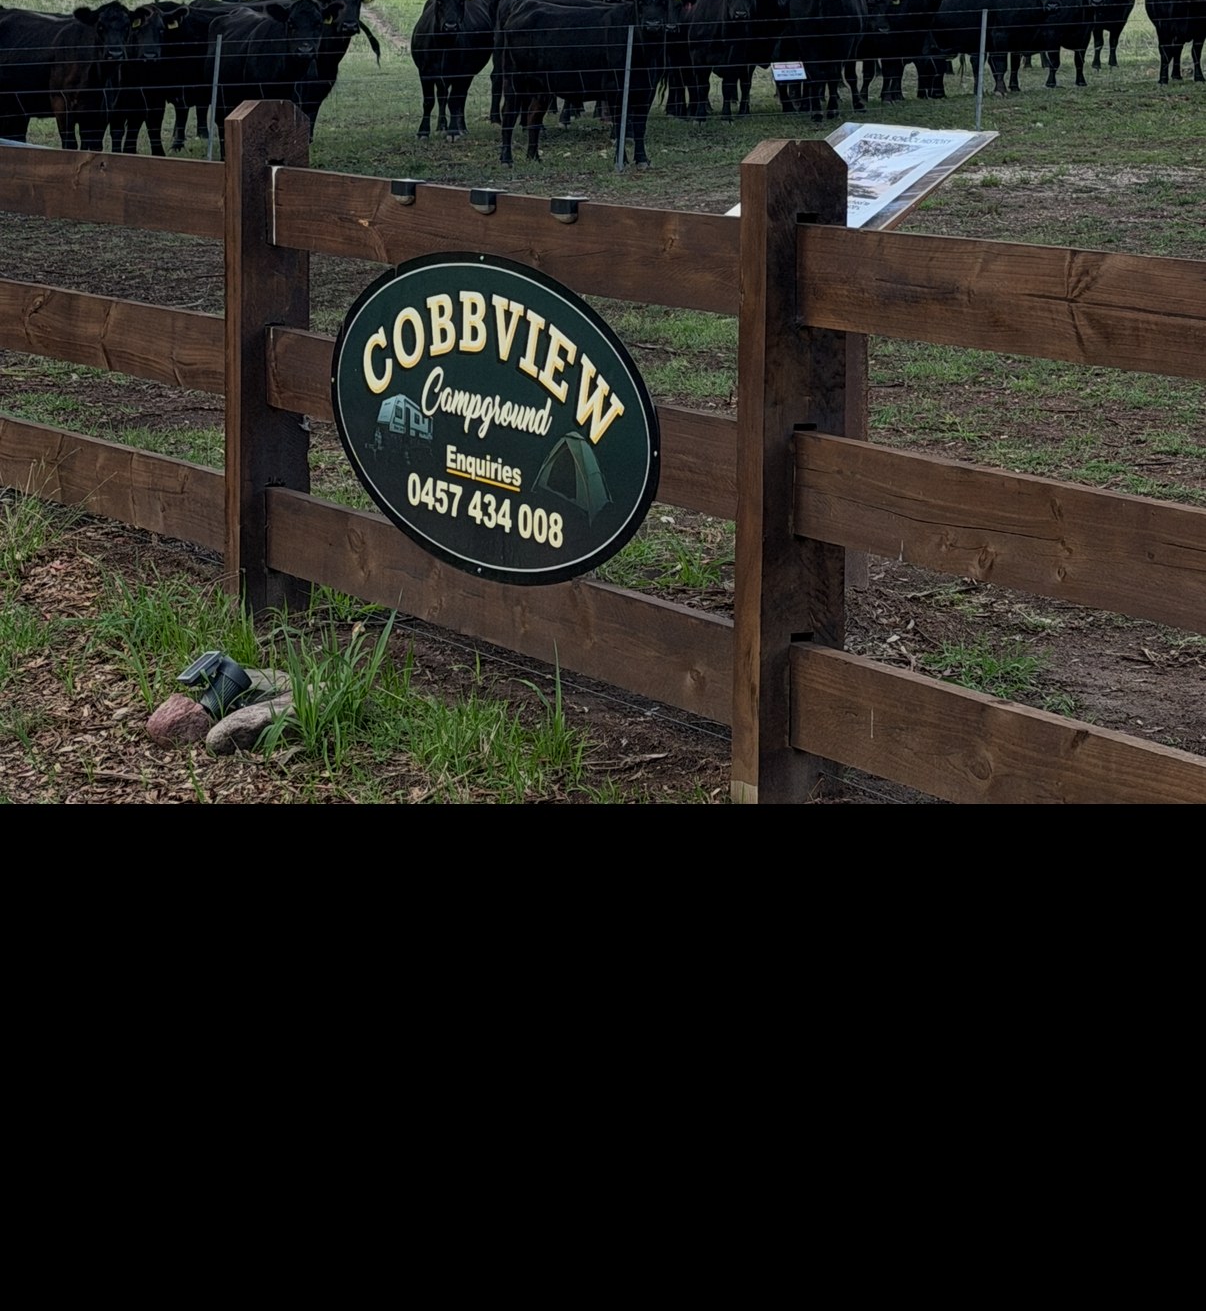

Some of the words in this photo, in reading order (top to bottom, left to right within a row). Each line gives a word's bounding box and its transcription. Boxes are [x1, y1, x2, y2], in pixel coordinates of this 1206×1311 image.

[363, 290, 625, 444] COBBVIEW
[421, 366, 553, 439] Campground
[446, 444, 522, 487] Enquiries
[407, 472, 463, 518] 0457
[468, 490, 512, 533] 434
[517, 503, 563, 549] 008
